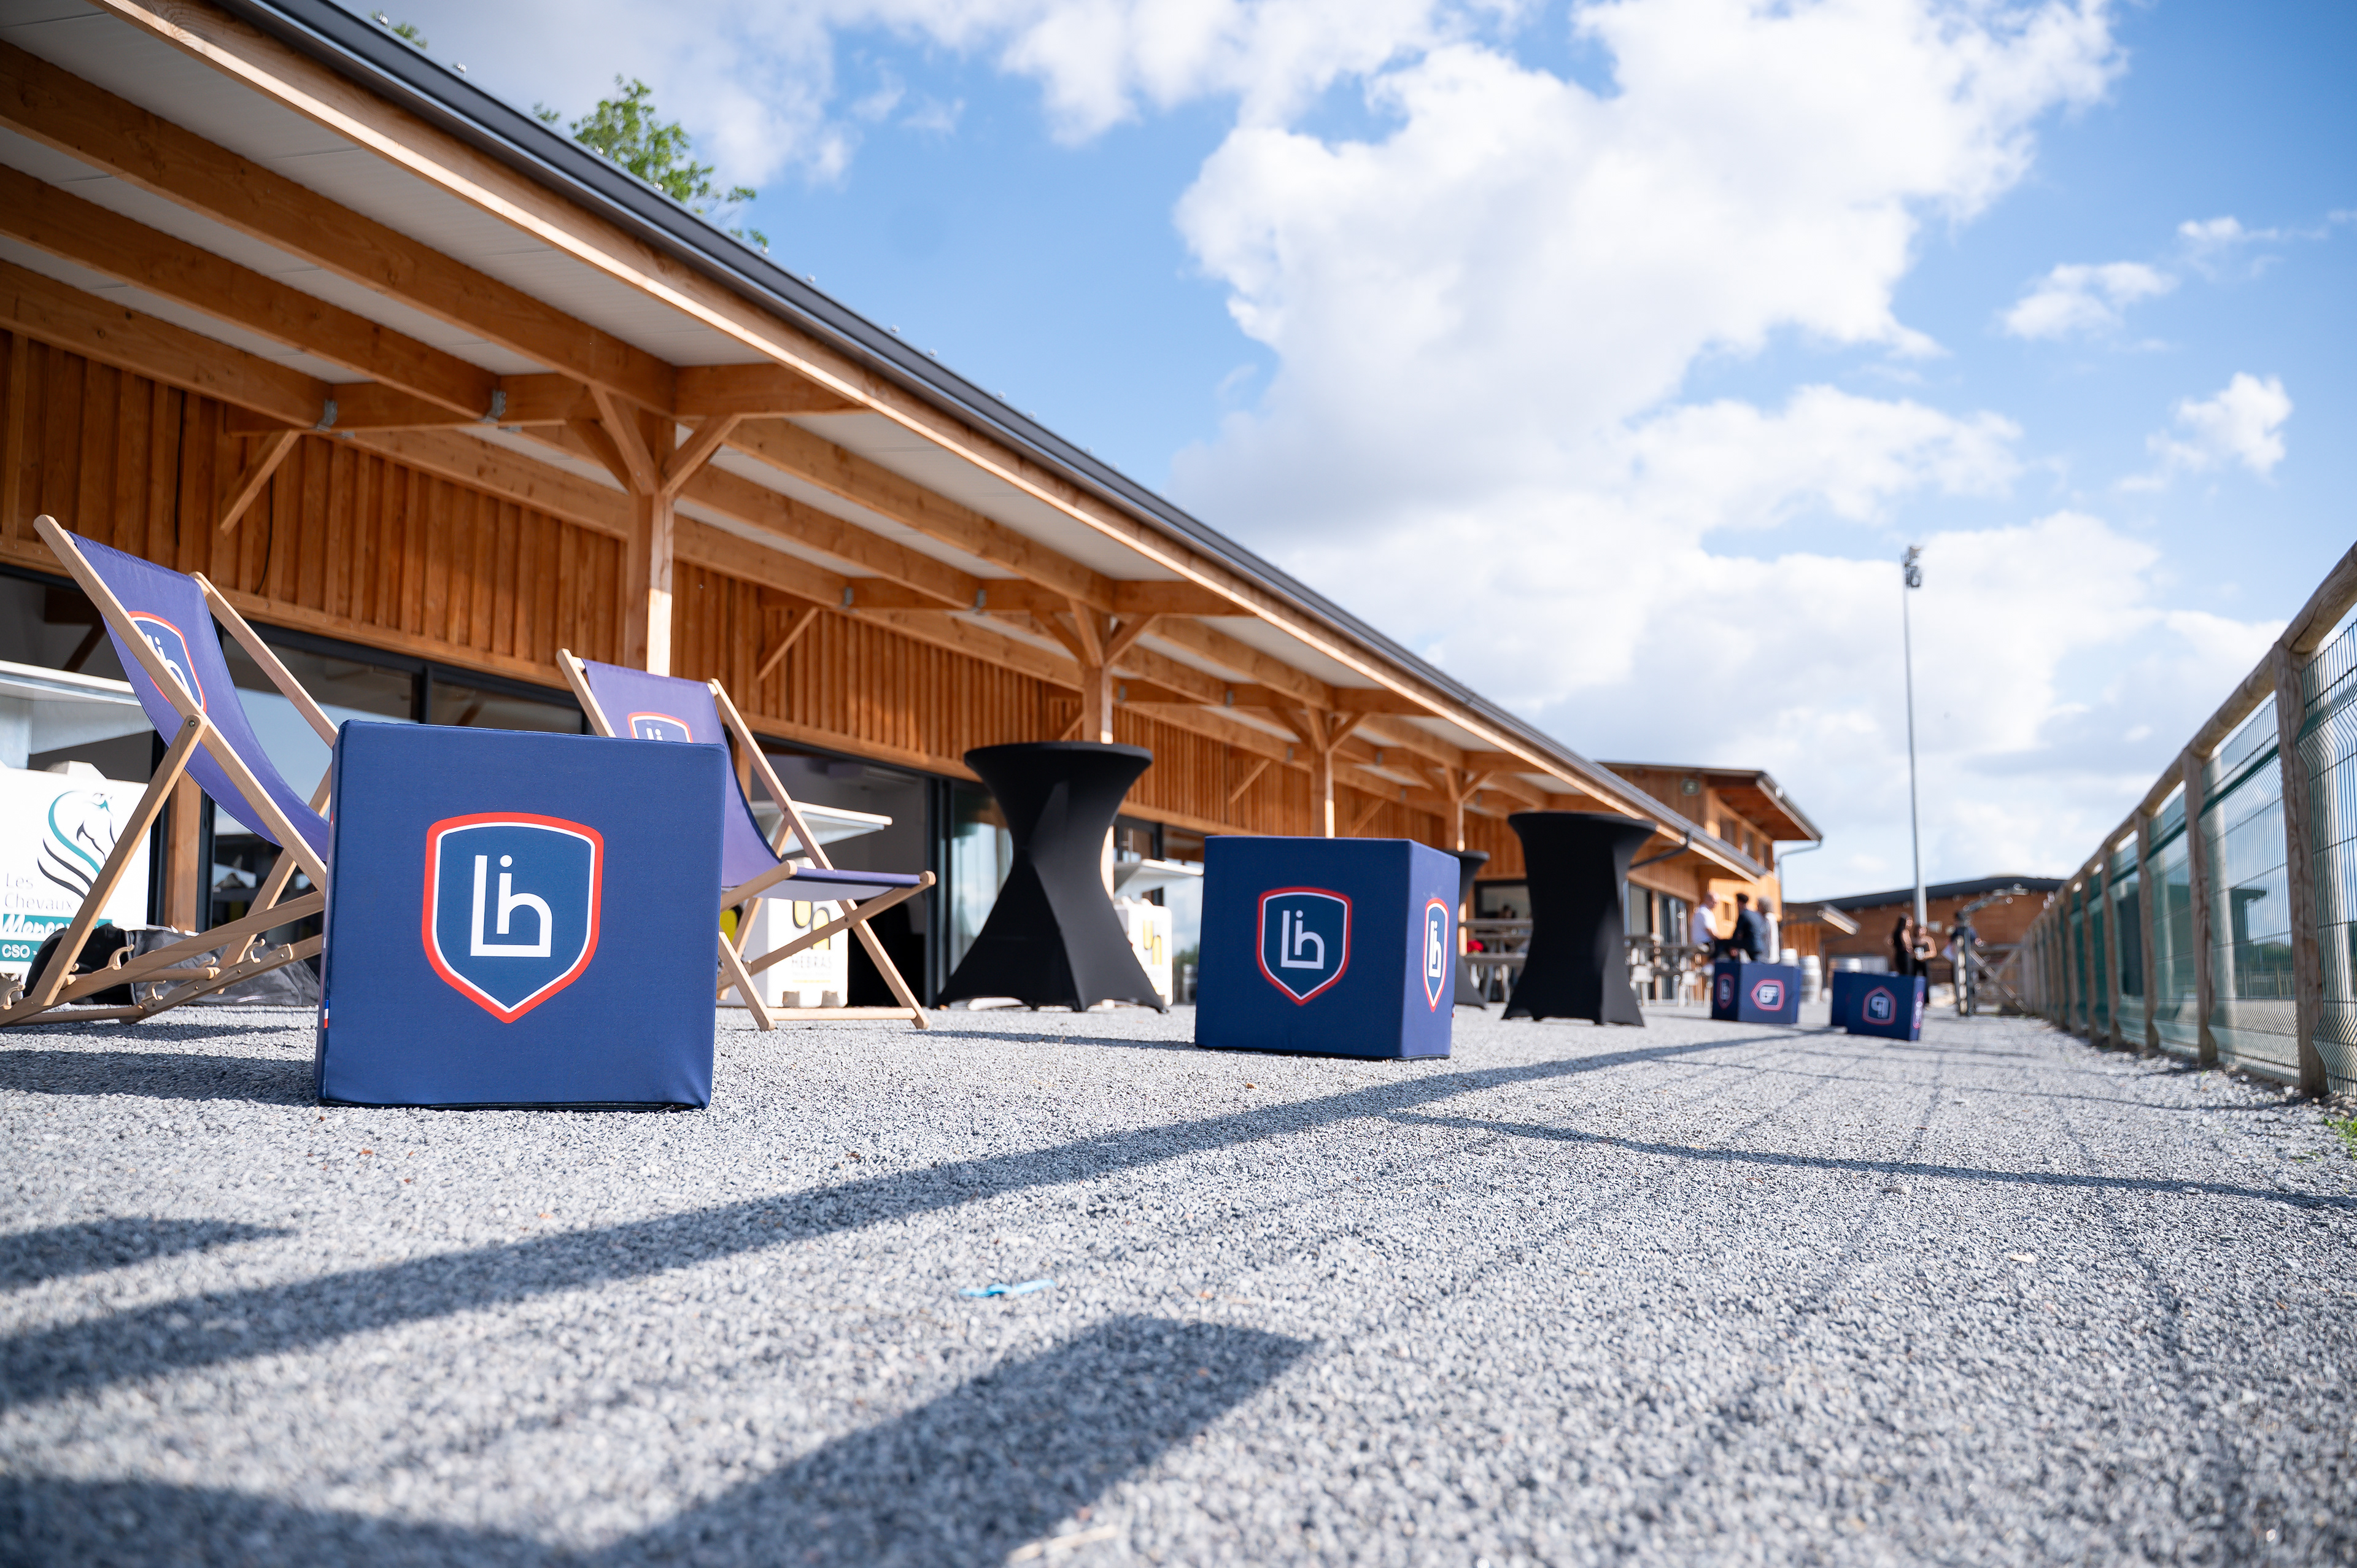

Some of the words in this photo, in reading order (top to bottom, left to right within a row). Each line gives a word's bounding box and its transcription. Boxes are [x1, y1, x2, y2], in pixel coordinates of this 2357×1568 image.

[6, 873, 34, 889] Les
[5, 892, 74, 911] Chevaux
[2, 943, 31, 959] CSO
